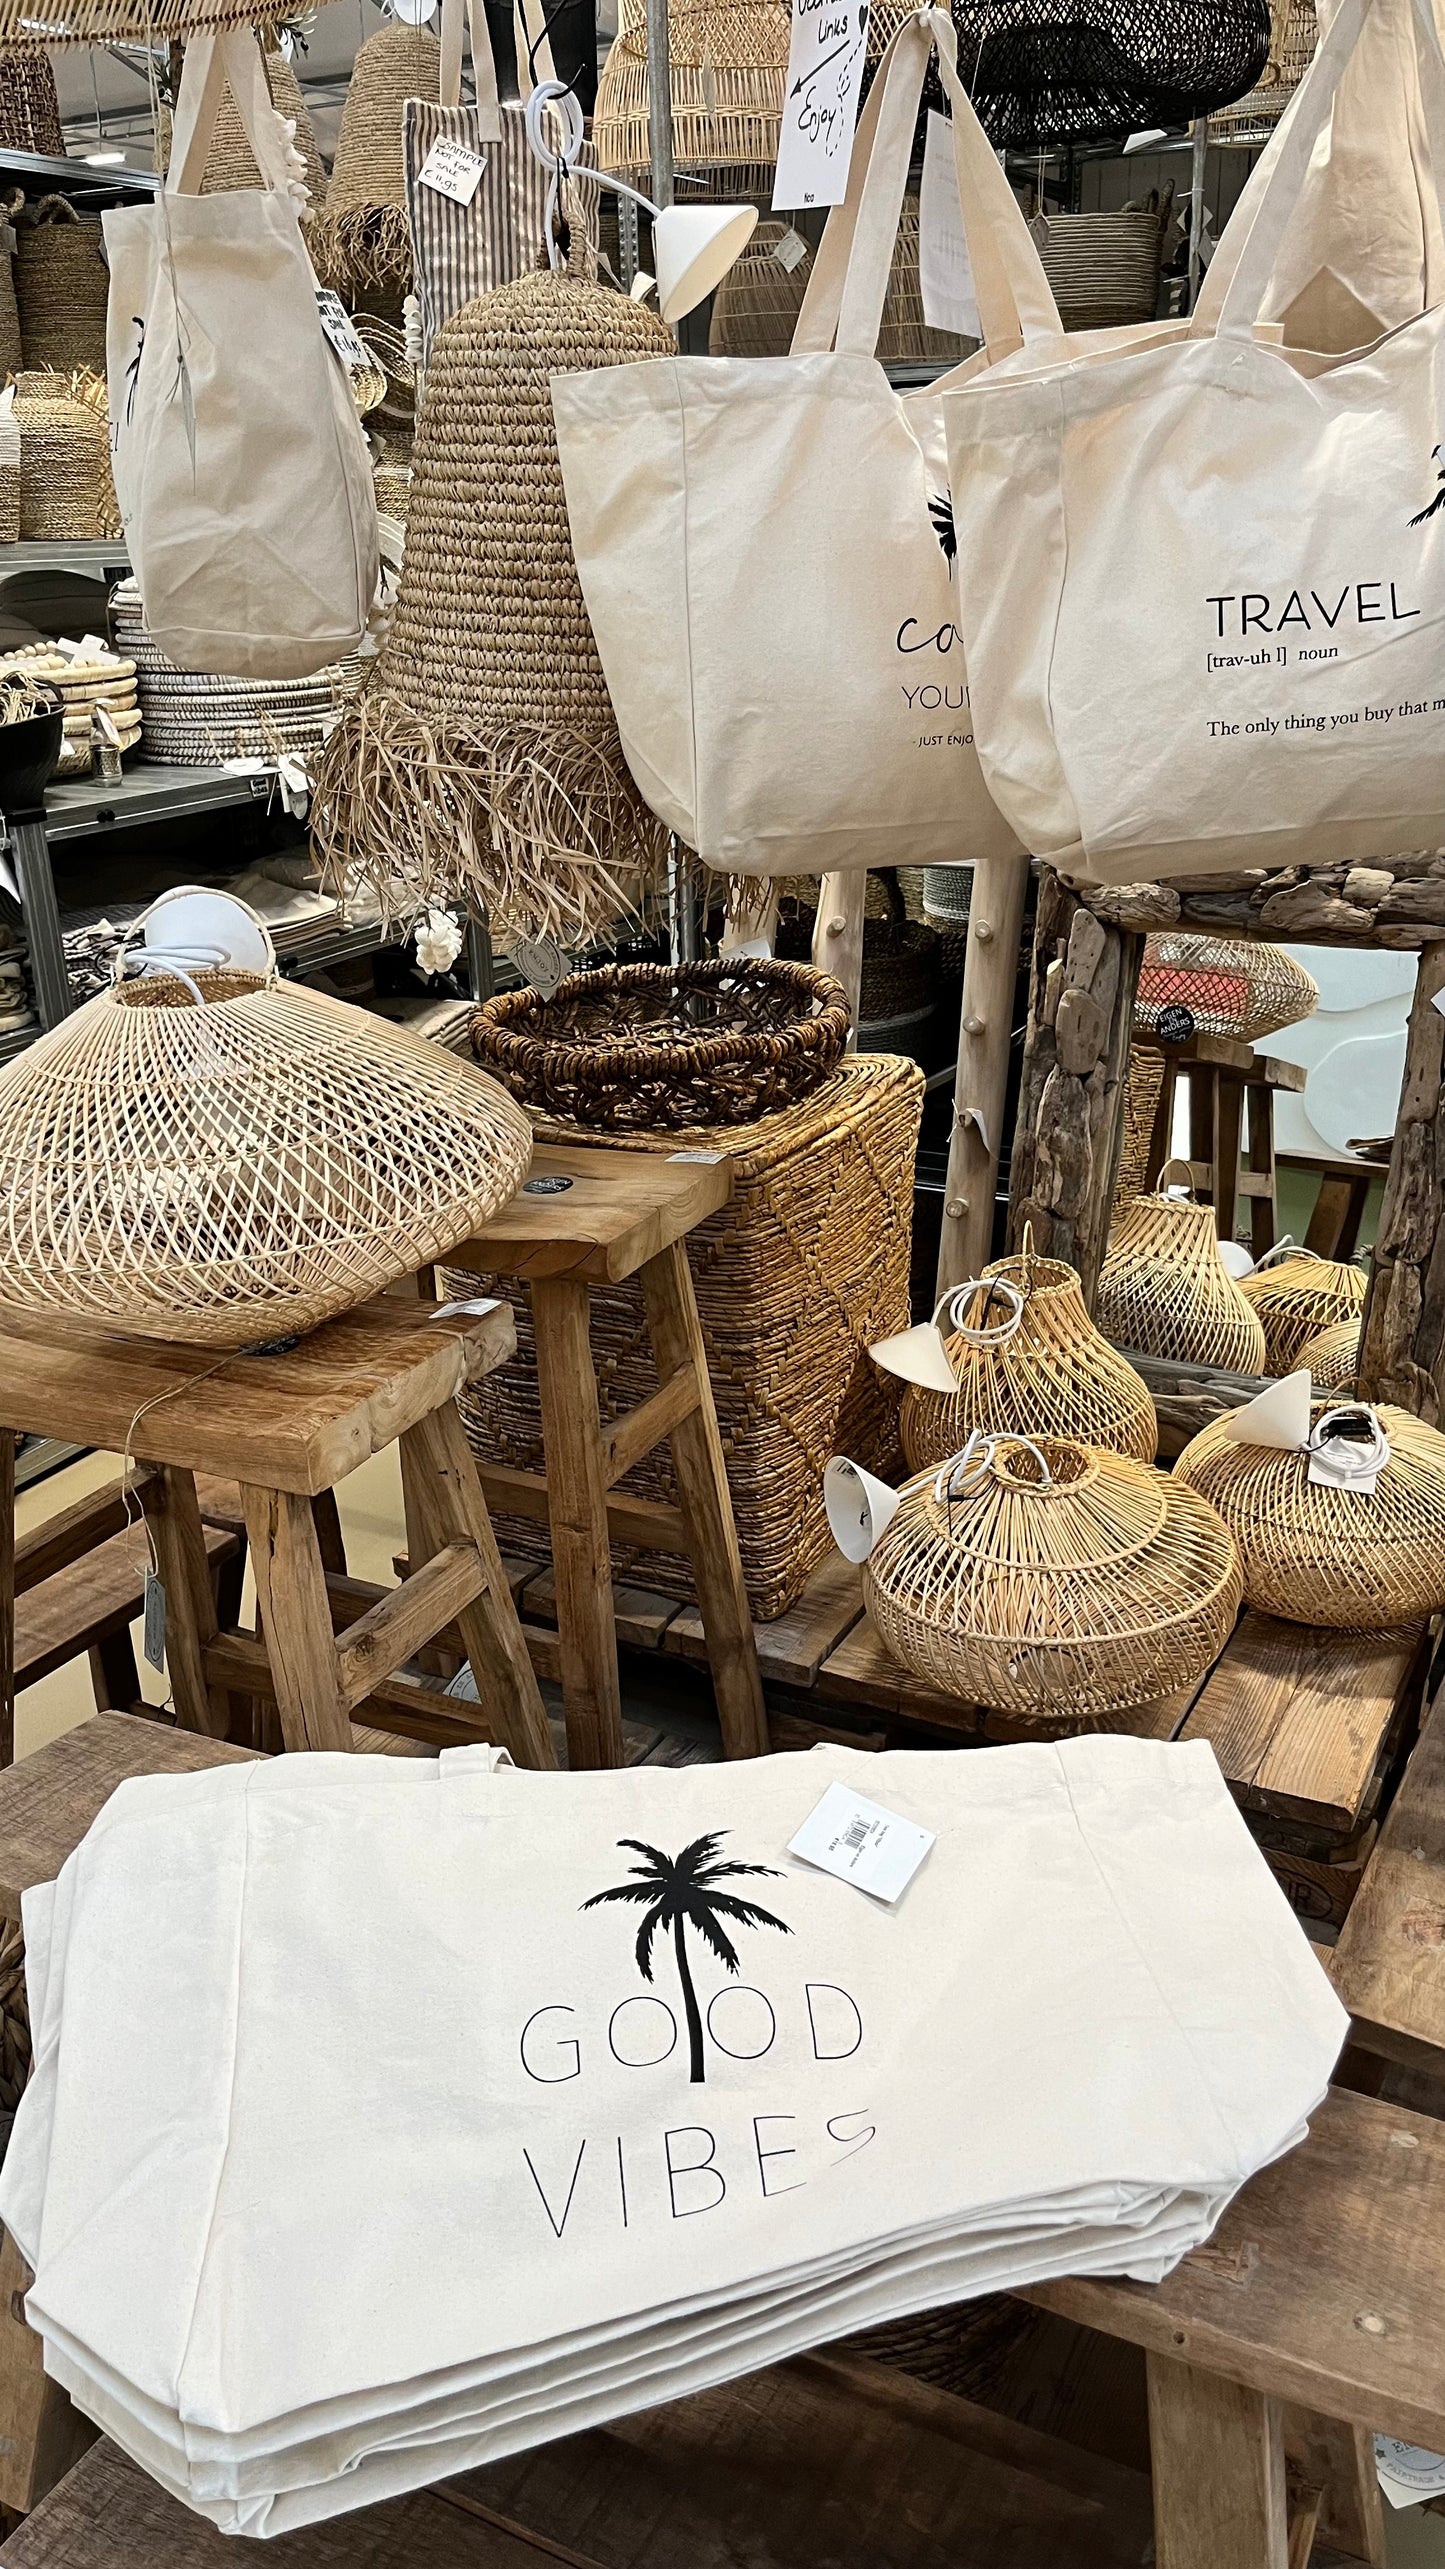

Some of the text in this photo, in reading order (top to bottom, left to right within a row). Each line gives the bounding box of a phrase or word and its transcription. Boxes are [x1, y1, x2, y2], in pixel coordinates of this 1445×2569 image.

[798, 86, 837, 145] Enjoy
[435, 148, 471, 175] NOT FOR
[443, 141, 484, 167] SAMPLE
[435, 162, 459, 177] SALE
[1206, 582, 1421, 637] TRAVEL
[1298, 648, 1339, 661] noun
[901, 685, 970, 709] YOU
[1206, 721, 1240, 737] The
[1245, 717, 1280, 736] only
[1285, 714, 1326, 732] thing
[1331, 713, 1359, 730] you
[1365, 706, 1394, 724] buy
[1399, 701, 1428, 716] that
[919, 734, 974, 748] JUST ENJO
[520, 1983, 863, 2083] GOOD
[522, 2108, 876, 2238] VIBES
